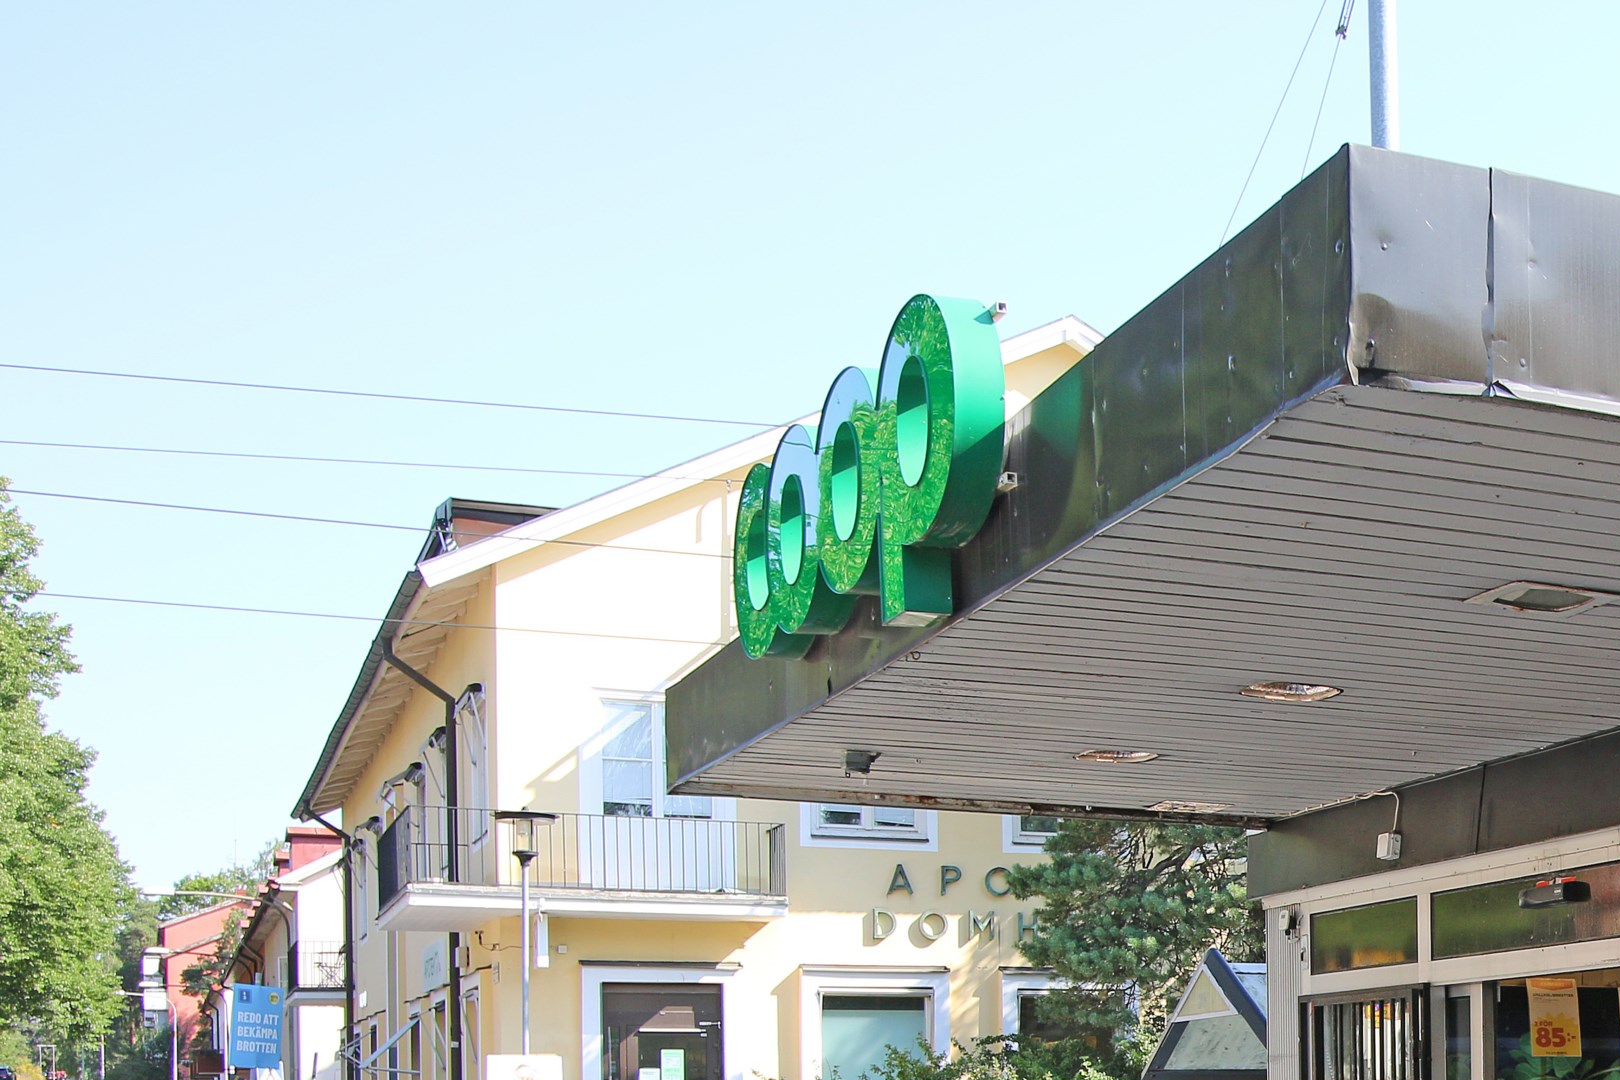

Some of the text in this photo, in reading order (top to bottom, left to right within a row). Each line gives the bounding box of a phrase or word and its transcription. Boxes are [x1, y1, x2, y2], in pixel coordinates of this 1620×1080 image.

[734, 294, 958, 660] coop
[237, 1011, 279, 1026] REDO ATT
[237, 1025, 278, 1040] BEKÄMPA
[236, 1040, 277, 1054] BROTTEN
